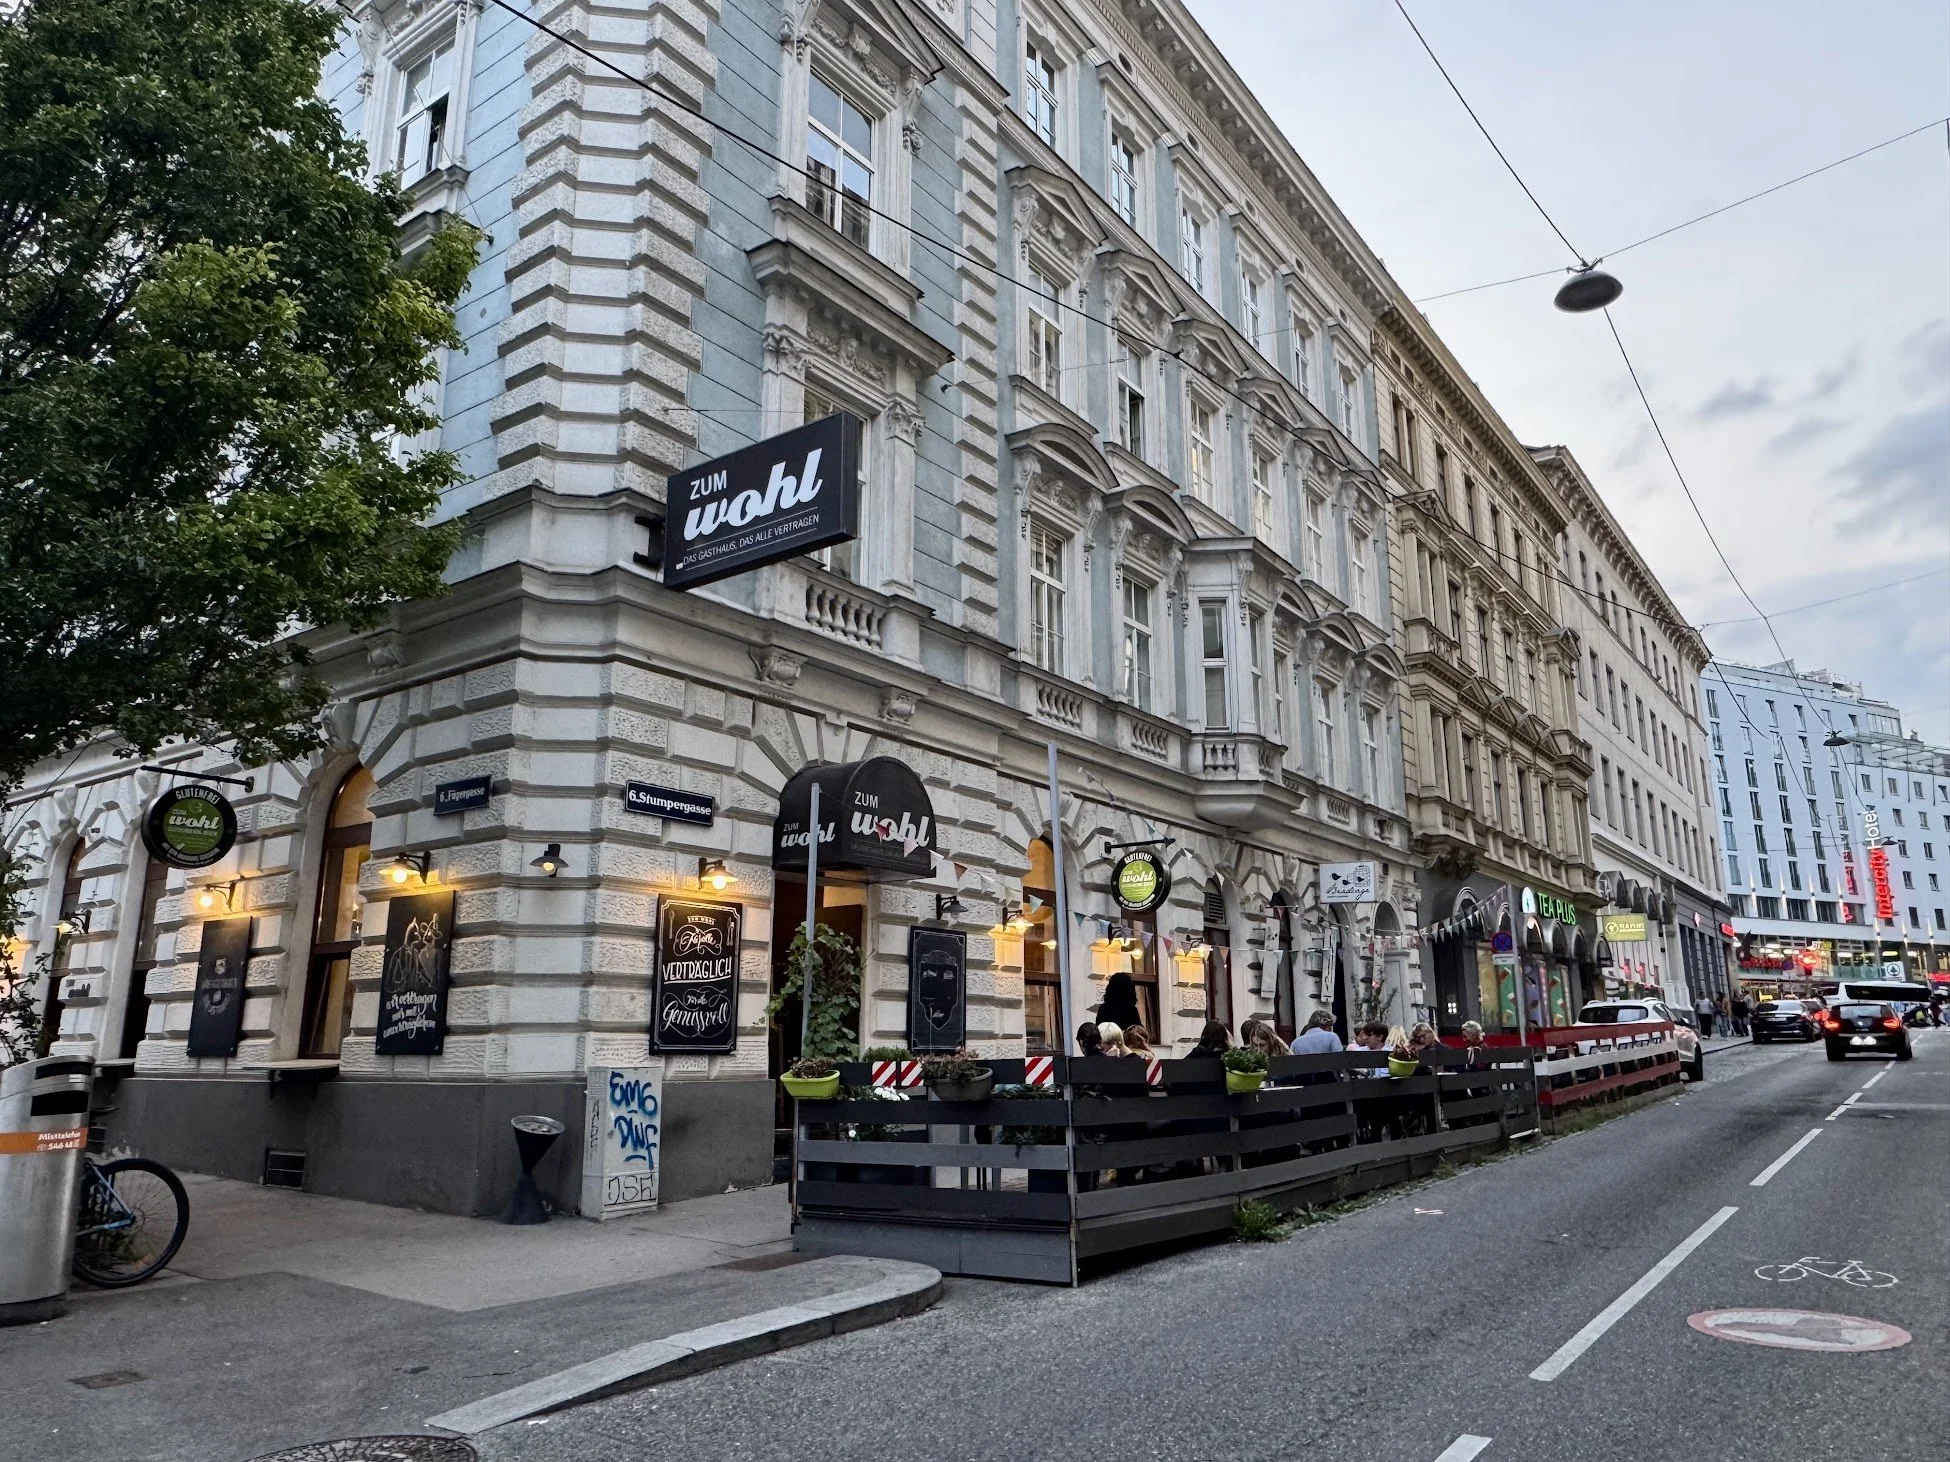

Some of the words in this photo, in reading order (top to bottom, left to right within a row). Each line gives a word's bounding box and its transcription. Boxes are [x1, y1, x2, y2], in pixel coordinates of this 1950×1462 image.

[683, 447, 824, 541] wohl
[689, 469, 728, 501] ZUM
[682, 552, 697, 567] DAS
[698, 541, 738, 562] GASTHAUS,
[739, 534, 754, 548] DAS
[755, 528, 773, 543] ALLE
[774, 513, 820, 537] VERTRAGEN
[855, 790, 879, 809] ZUM
[169, 815, 221, 830] wohl
[783, 822, 799, 832] ZUM
[850, 811, 931, 847] wohl
[1121, 870, 1154, 883] wohl
[1536, 892, 1555, 918] TEA
[1556, 899, 1577, 926] PLUS
[662, 956, 732, 981] VERTRÄGLICH
